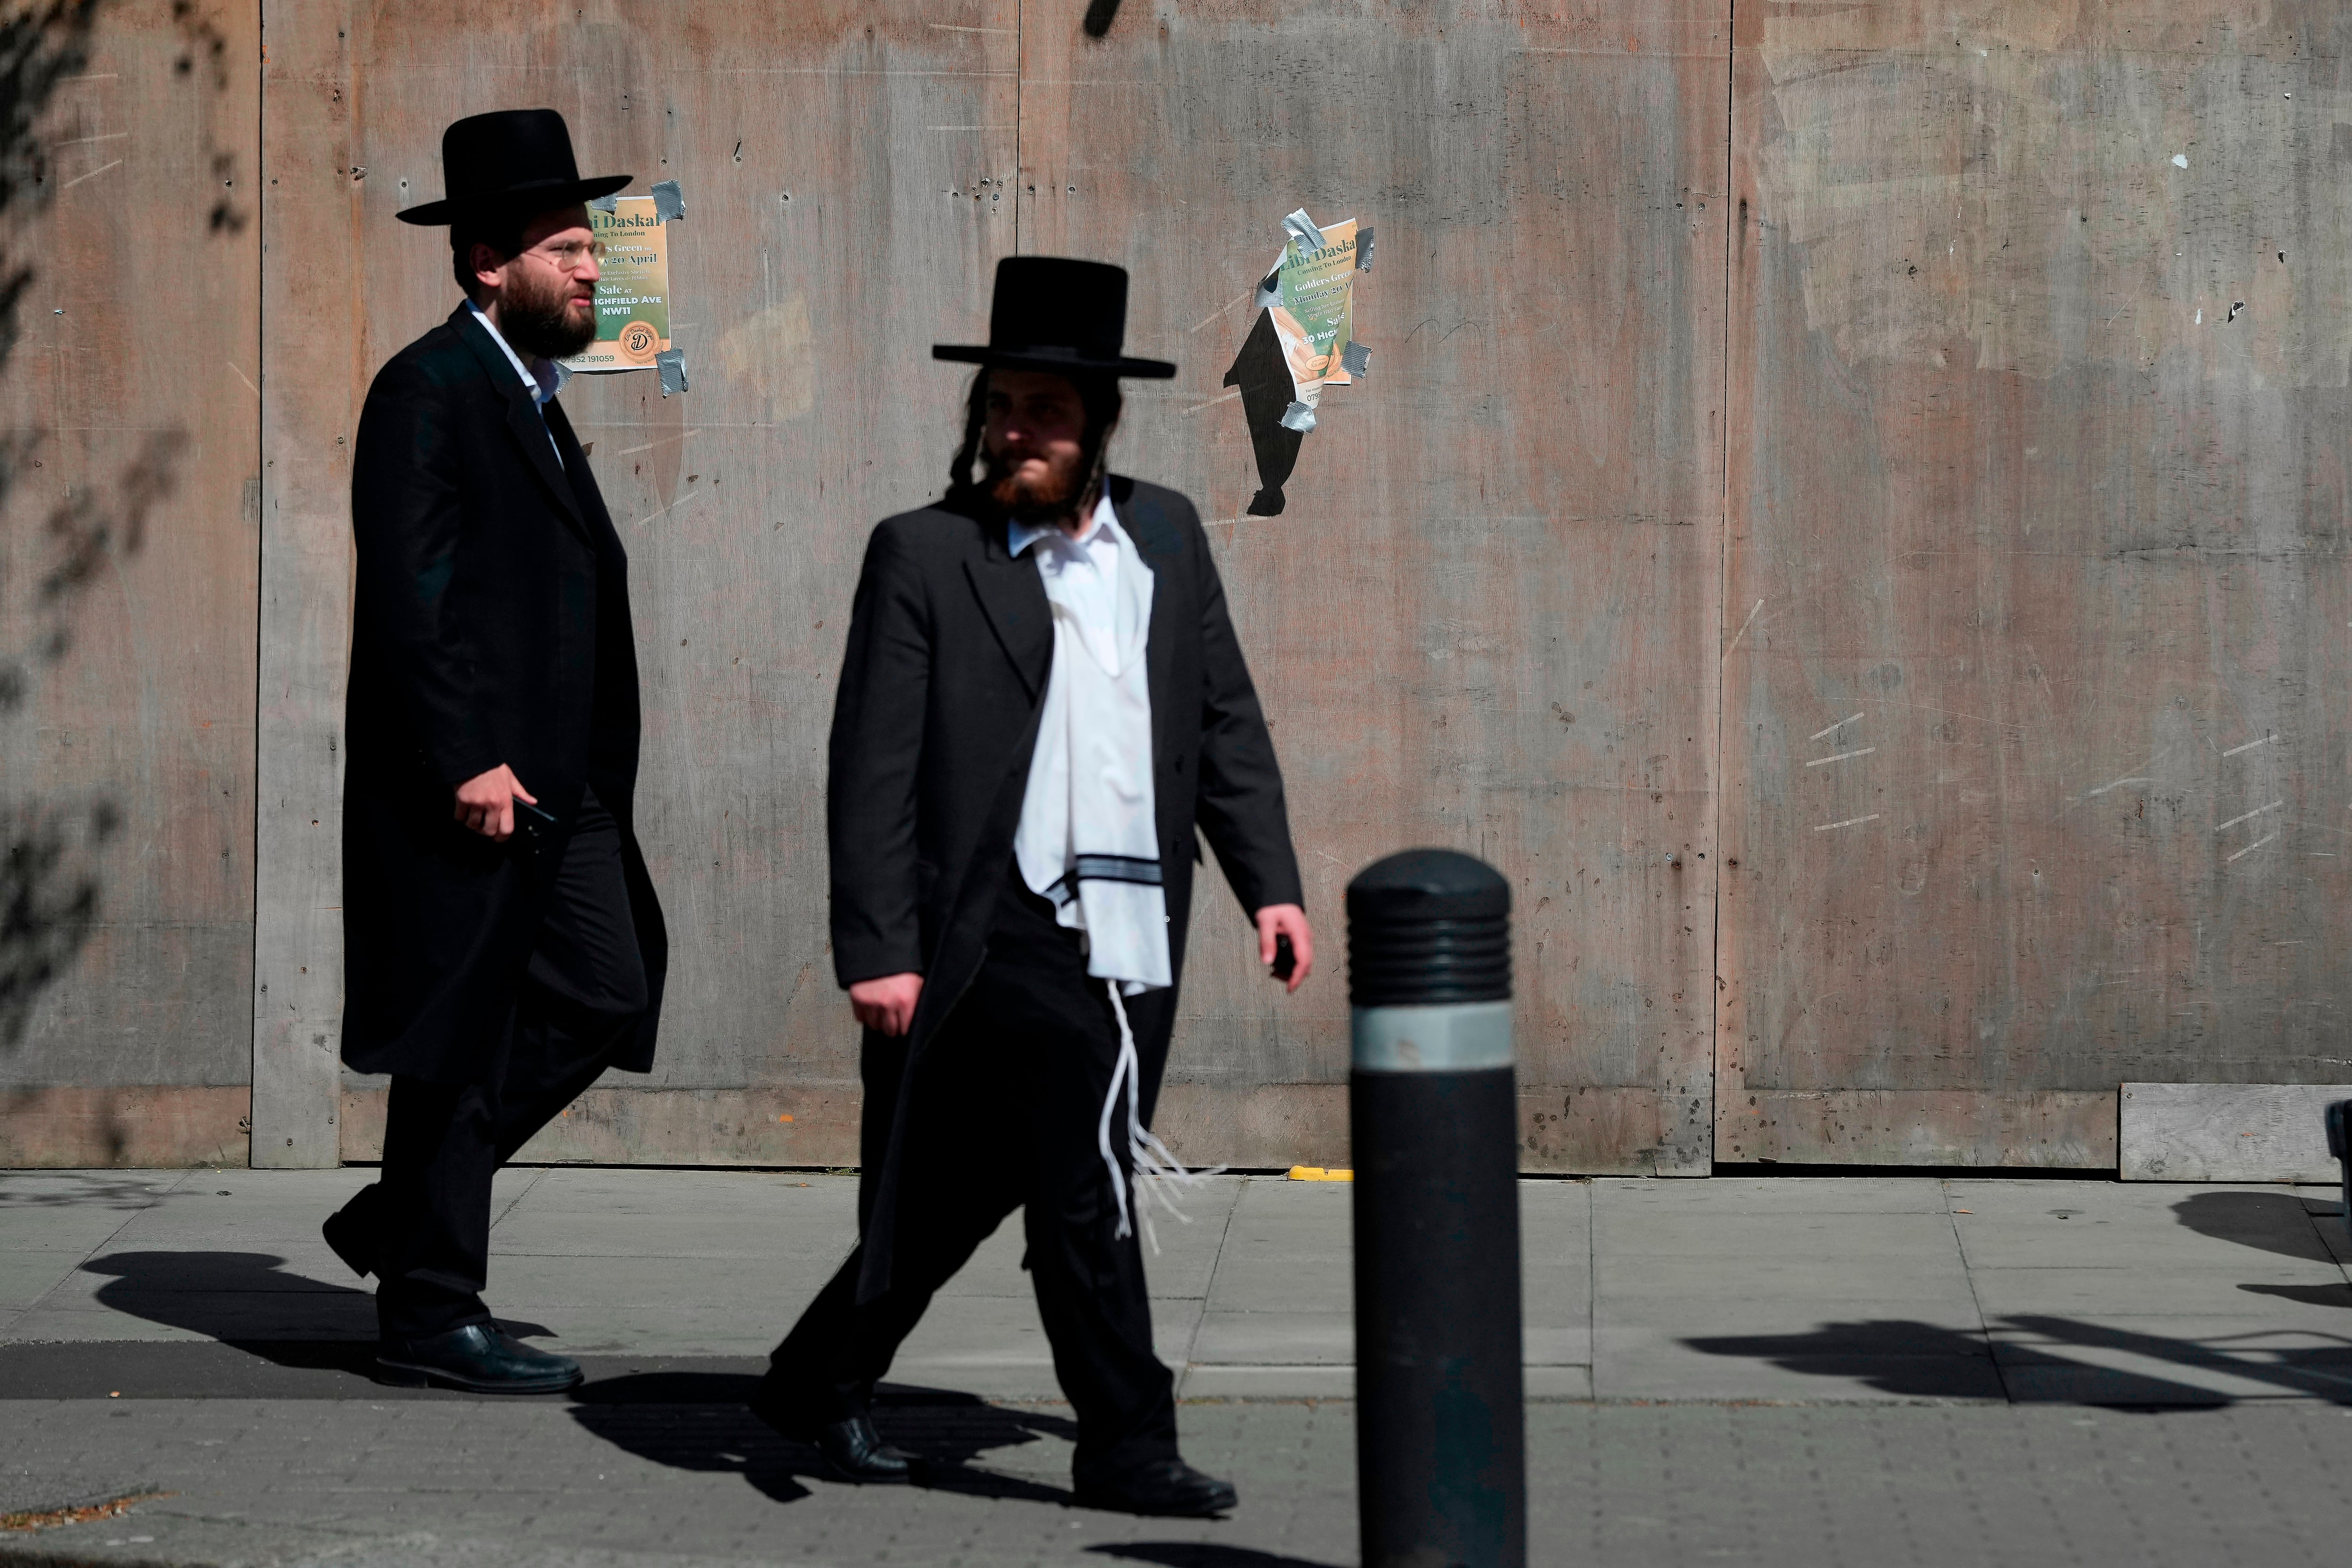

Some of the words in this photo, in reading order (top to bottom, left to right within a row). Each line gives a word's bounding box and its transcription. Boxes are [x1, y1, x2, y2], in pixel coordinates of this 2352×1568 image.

[603, 213, 660, 229] Daskal
[627, 253, 658, 266] April
[1297, 265, 1322, 276] Coming
[1332, 255, 1351, 265] London
[1295, 277, 1330, 293] Golders
[1330, 270, 1352, 282] Green
[600, 285, 622, 294] Sale
[1293, 289, 1329, 306] Monday
[1330, 284, 1343, 295] 20
[593, 297, 639, 306] IGHFIELD
[641, 295, 662, 304] AVE
[602, 306, 631, 316] NW11
[1307, 310, 1324, 319] Virgin
[1327, 314, 1340, 327] Sal
[1302, 334, 1315, 346] 30
[1317, 328, 1338, 341] HIGH
[1307, 390, 1322, 401] 0795
